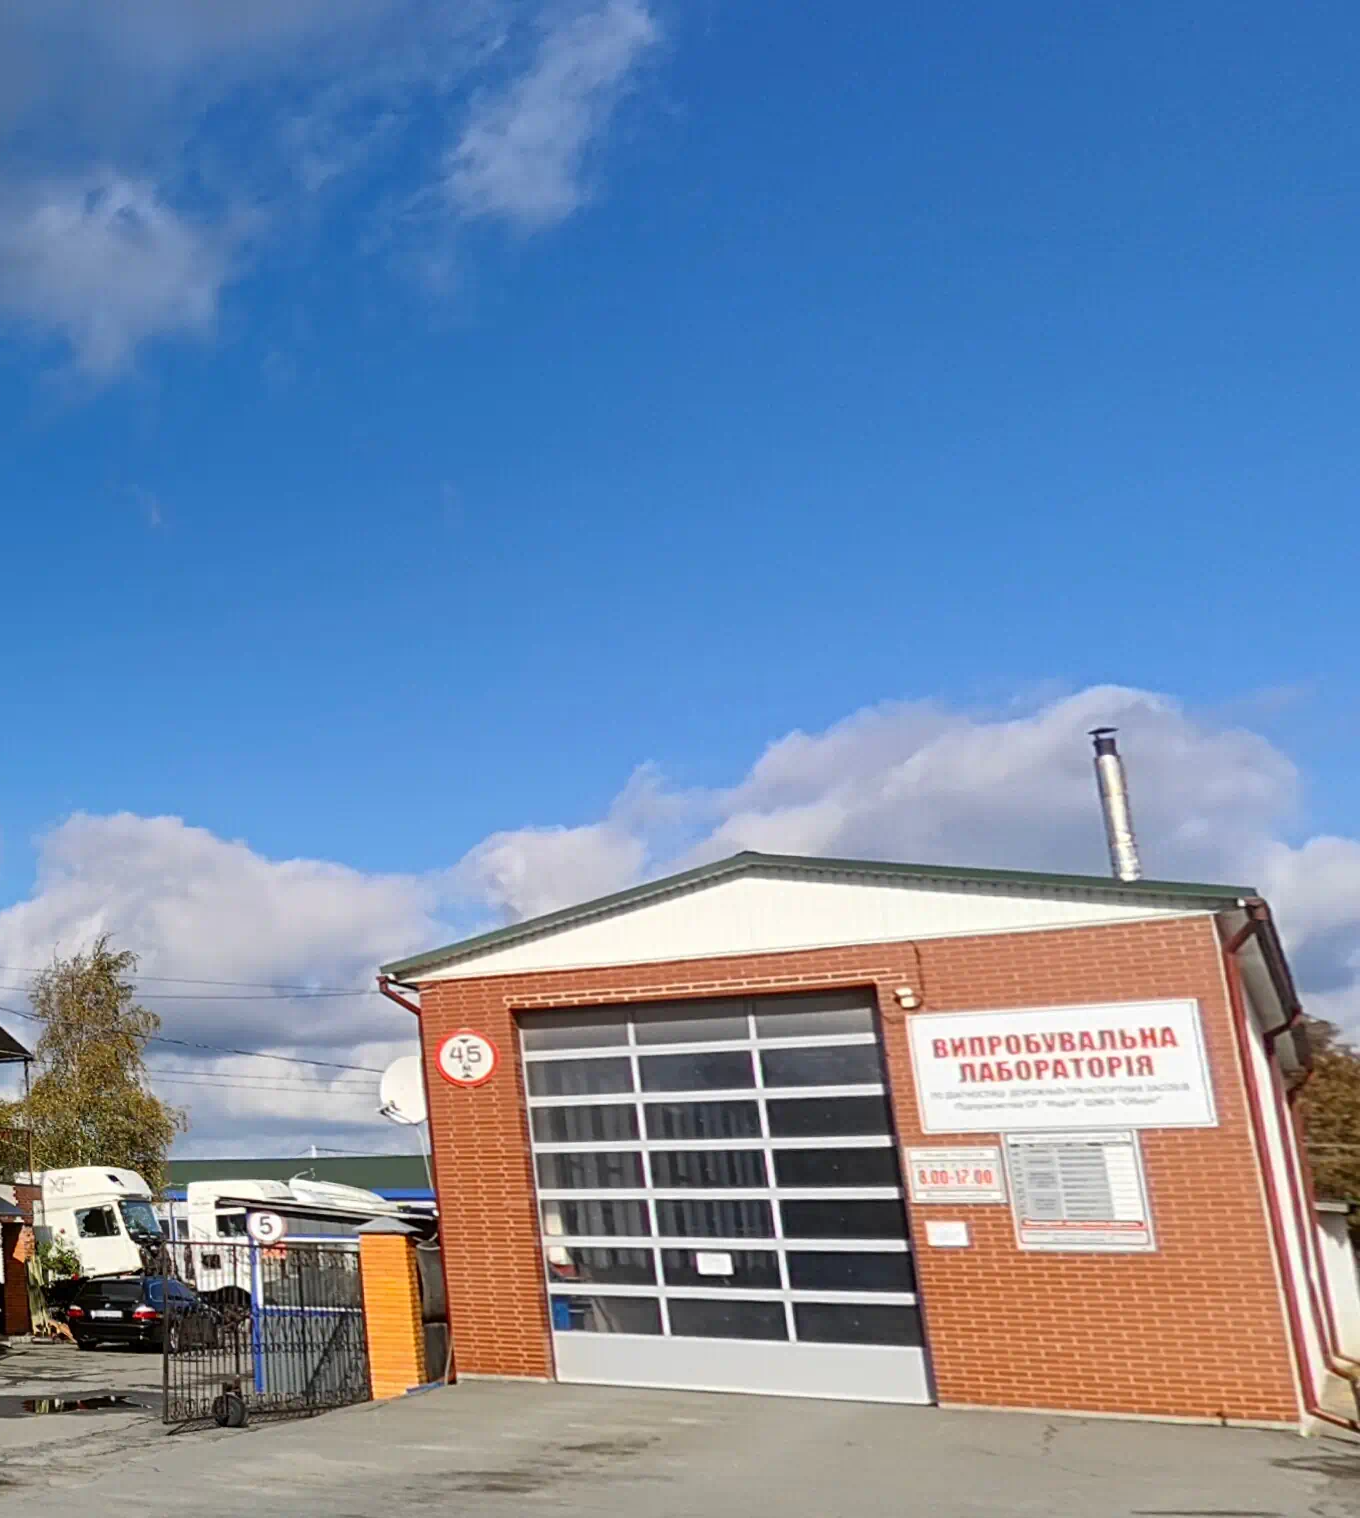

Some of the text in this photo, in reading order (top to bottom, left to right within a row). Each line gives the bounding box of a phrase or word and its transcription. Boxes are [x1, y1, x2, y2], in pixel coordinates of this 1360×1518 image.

[931, 1026, 1179, 1059] ВИПРОБУВАЛЬНА
[958, 1055, 1156, 1083] ЛАБОРАТОРІЯ
[260, 1216, 273, 1235] 5
